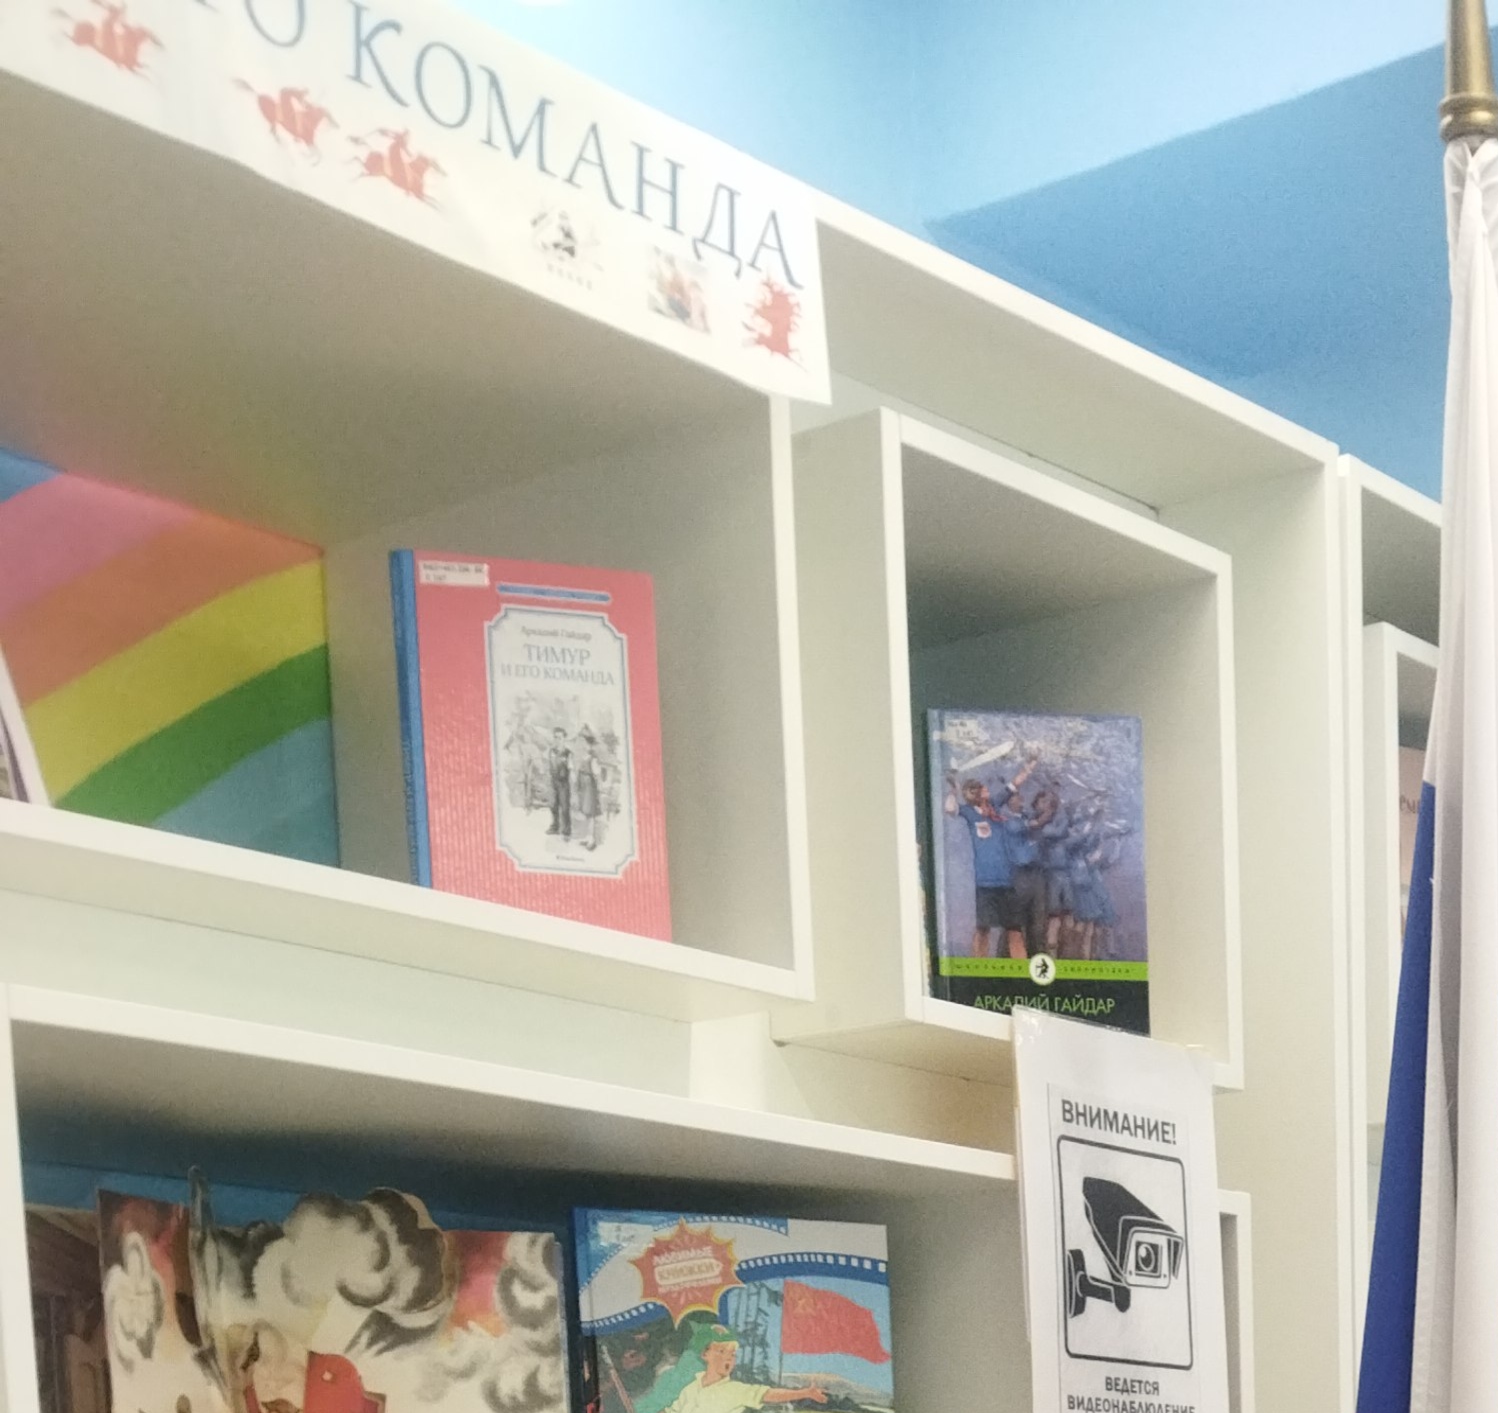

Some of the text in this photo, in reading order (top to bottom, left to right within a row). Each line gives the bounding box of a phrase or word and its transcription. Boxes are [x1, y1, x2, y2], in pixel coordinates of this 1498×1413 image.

[346, 1, 804, 290] КОМАНДА
[523, 642, 591, 667] ТИМУР
[515, 665, 541, 681] ЕГО
[543, 666, 615, 687] КОМАНДА
[973, 992, 1115, 1017] АРКАДИЙ ГАЙДАР
[1061, 1098, 1177, 1146] ВНИМАНИЕ!
[1104, 1376, 1160, 1397] ВЕДЕТСЯ
